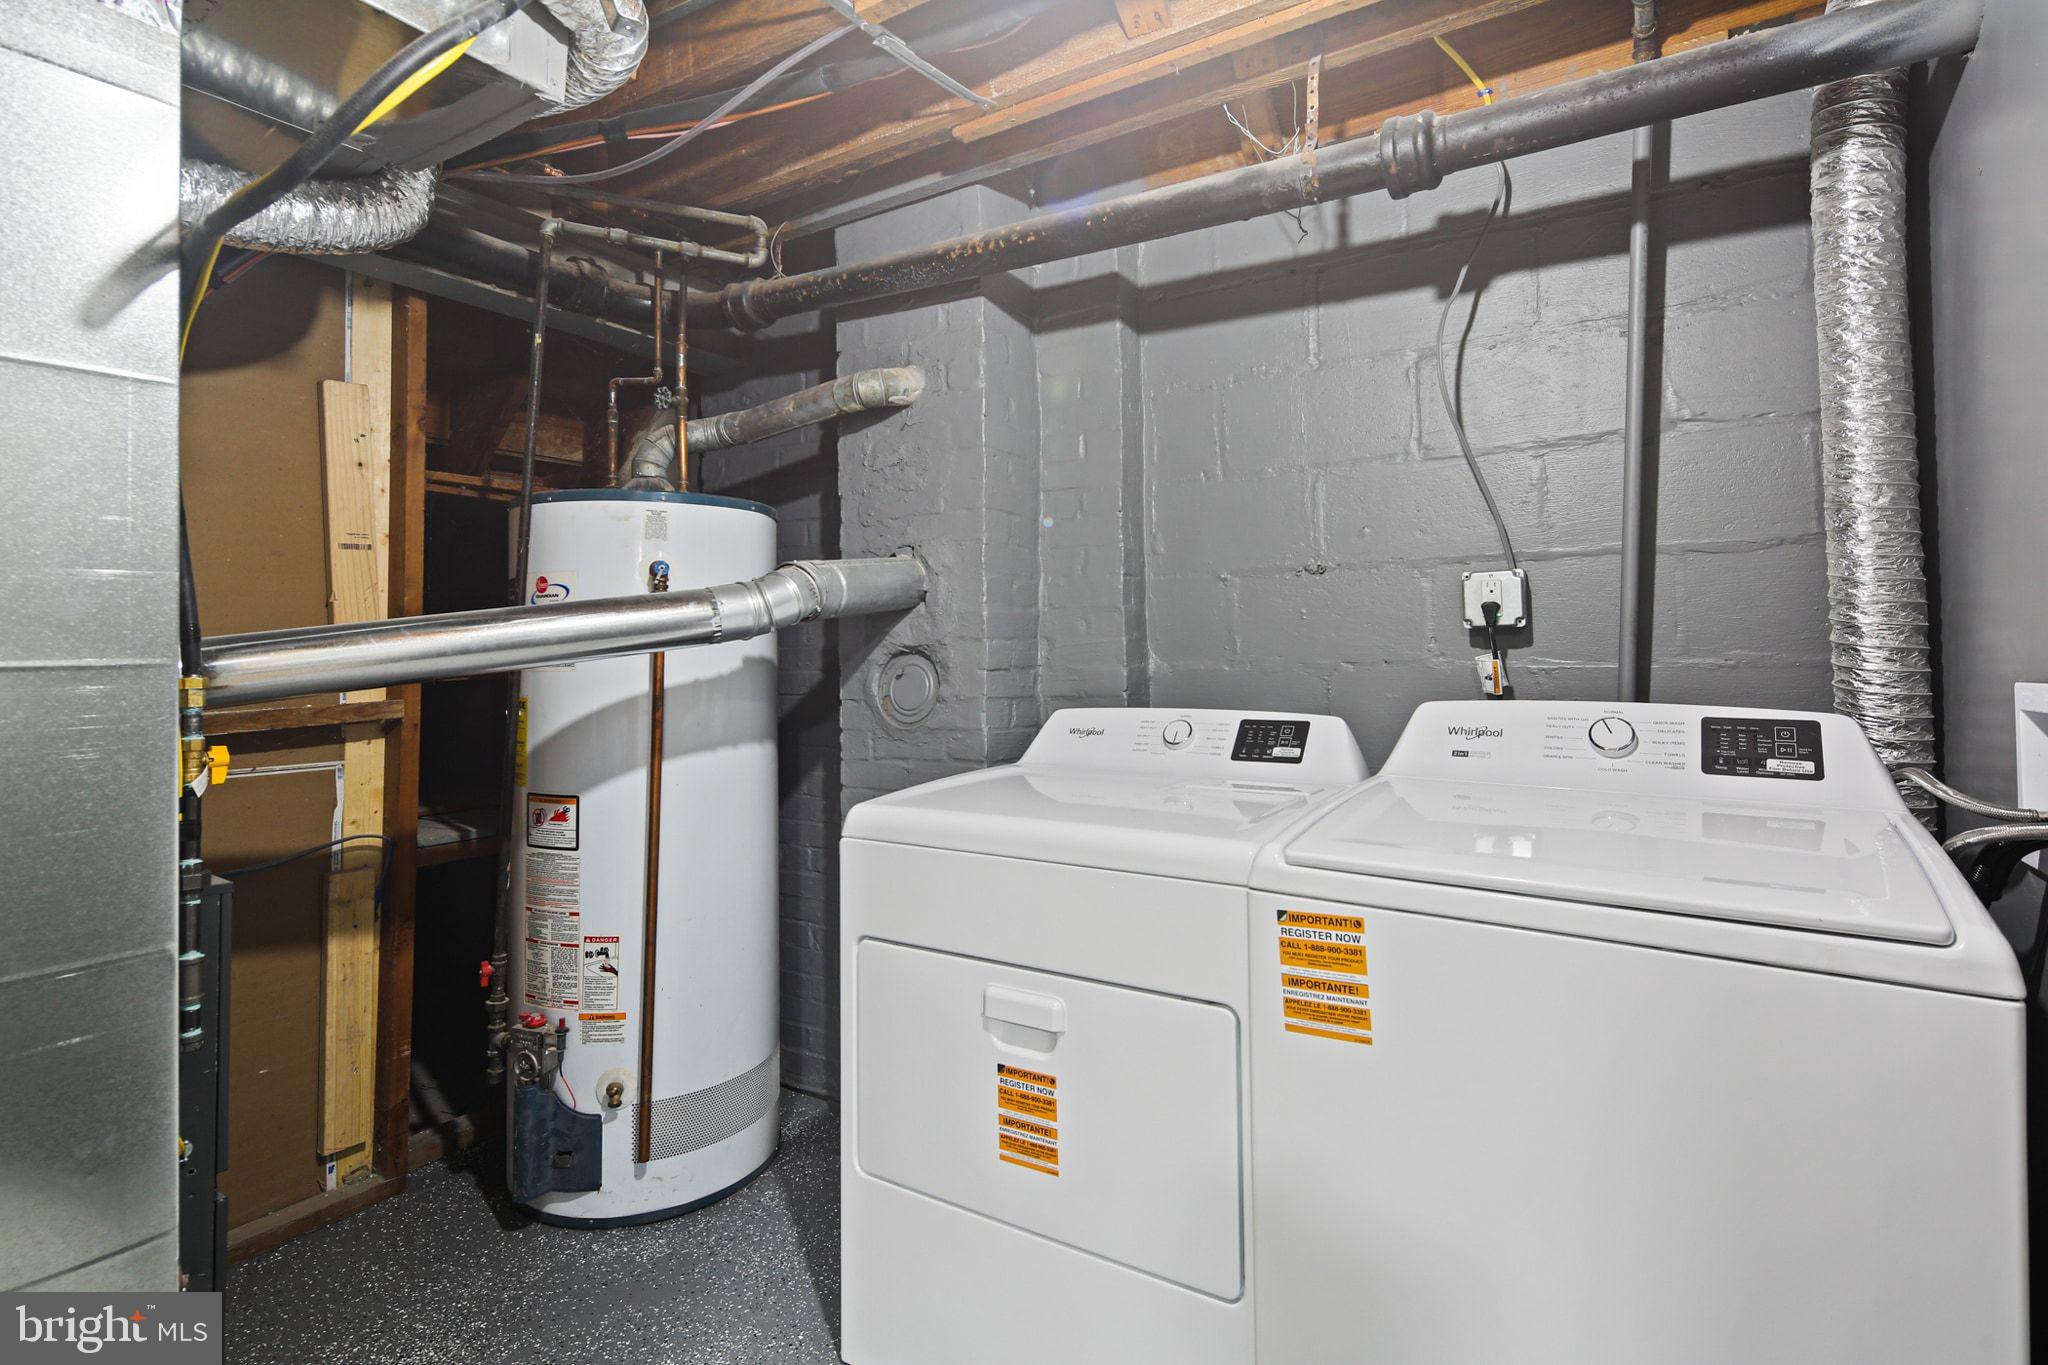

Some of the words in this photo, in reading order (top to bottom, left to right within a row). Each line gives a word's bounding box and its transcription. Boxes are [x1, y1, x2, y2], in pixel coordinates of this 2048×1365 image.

[1069, 727, 1105, 739] Whirlpool
[1448, 726, 1503, 740] Whirlpool
[1288, 914, 1353, 928] IMPORTANT!
[1280, 927, 1333, 941] REGISTER
[1335, 933, 1361, 944] NOW
[1280, 941, 1302, 950] CALL
[1304, 943, 1363, 957] 1-888-900-3381
[1288, 978, 1359, 995] IMPORTANTE!
[1284, 998, 1312, 1008] APPELEZ
[1326, 995, 1368, 1006] MAINTENANT
[1000, 1077, 1035, 1092] REGISTER
[1036, 1086, 1055, 1097] NOW
[1000, 1088, 1014, 1096] CALL
